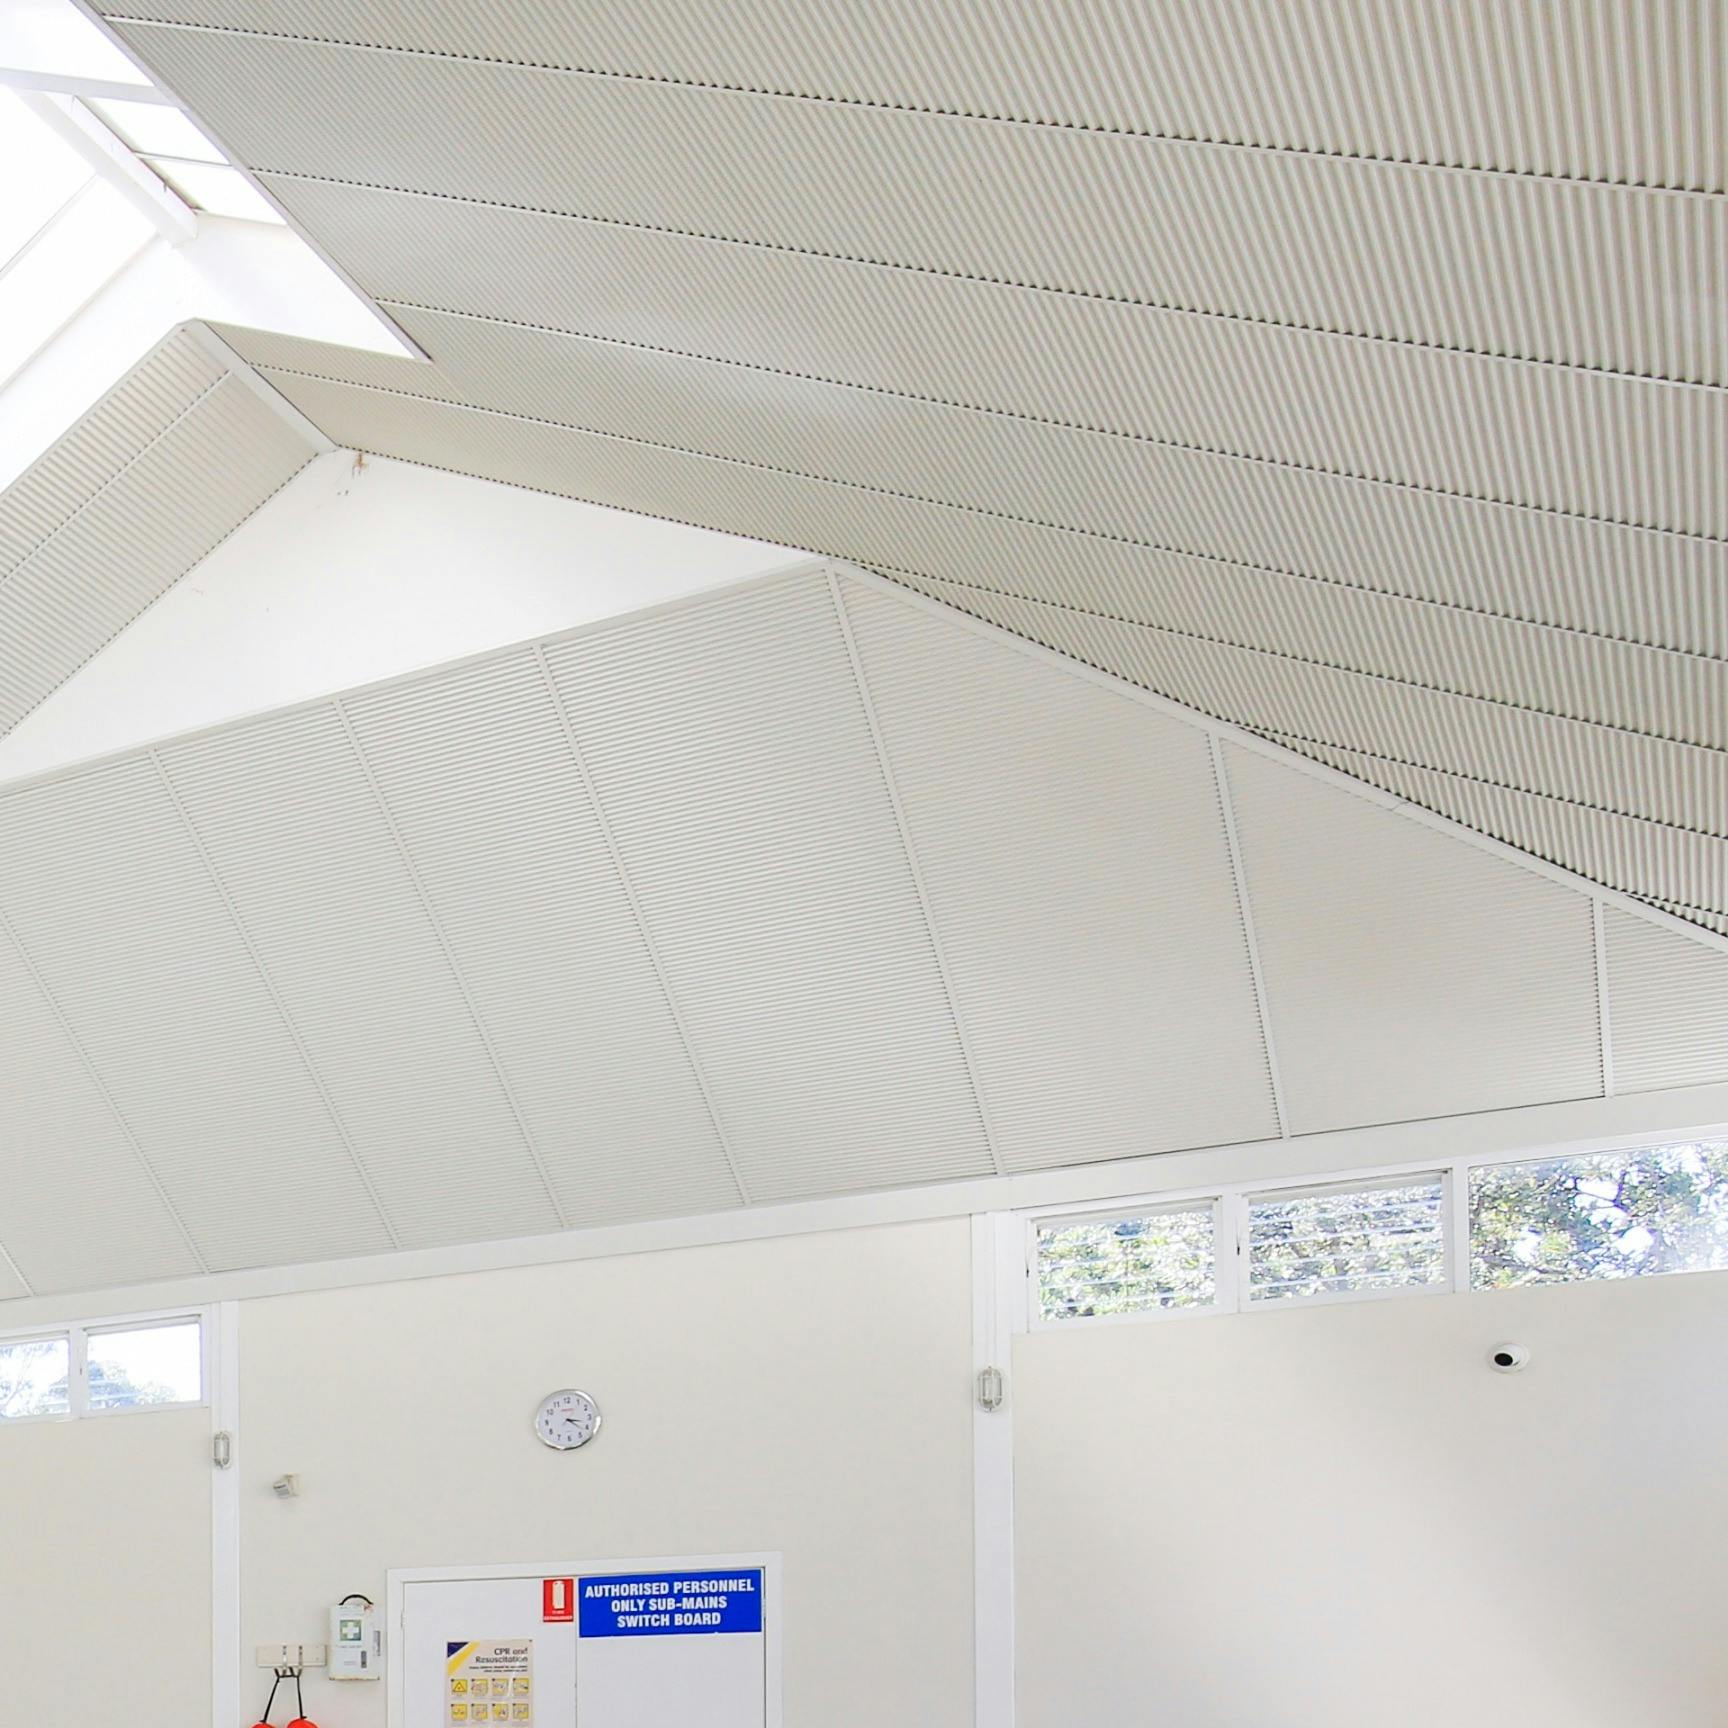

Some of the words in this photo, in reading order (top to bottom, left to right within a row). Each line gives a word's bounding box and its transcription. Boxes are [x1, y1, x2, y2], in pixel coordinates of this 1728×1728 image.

[585, 1582, 669, 1598] AUTHORISED
[673, 1579, 754, 1594] PERSONNEL
[611, 1599, 646, 1612] ONLY
[648, 1596, 727, 1611] SUB-MAINS
[617, 1614, 670, 1628] SWITCH
[674, 1612, 721, 1626] BOARD
[513, 1647, 528, 1655] and
